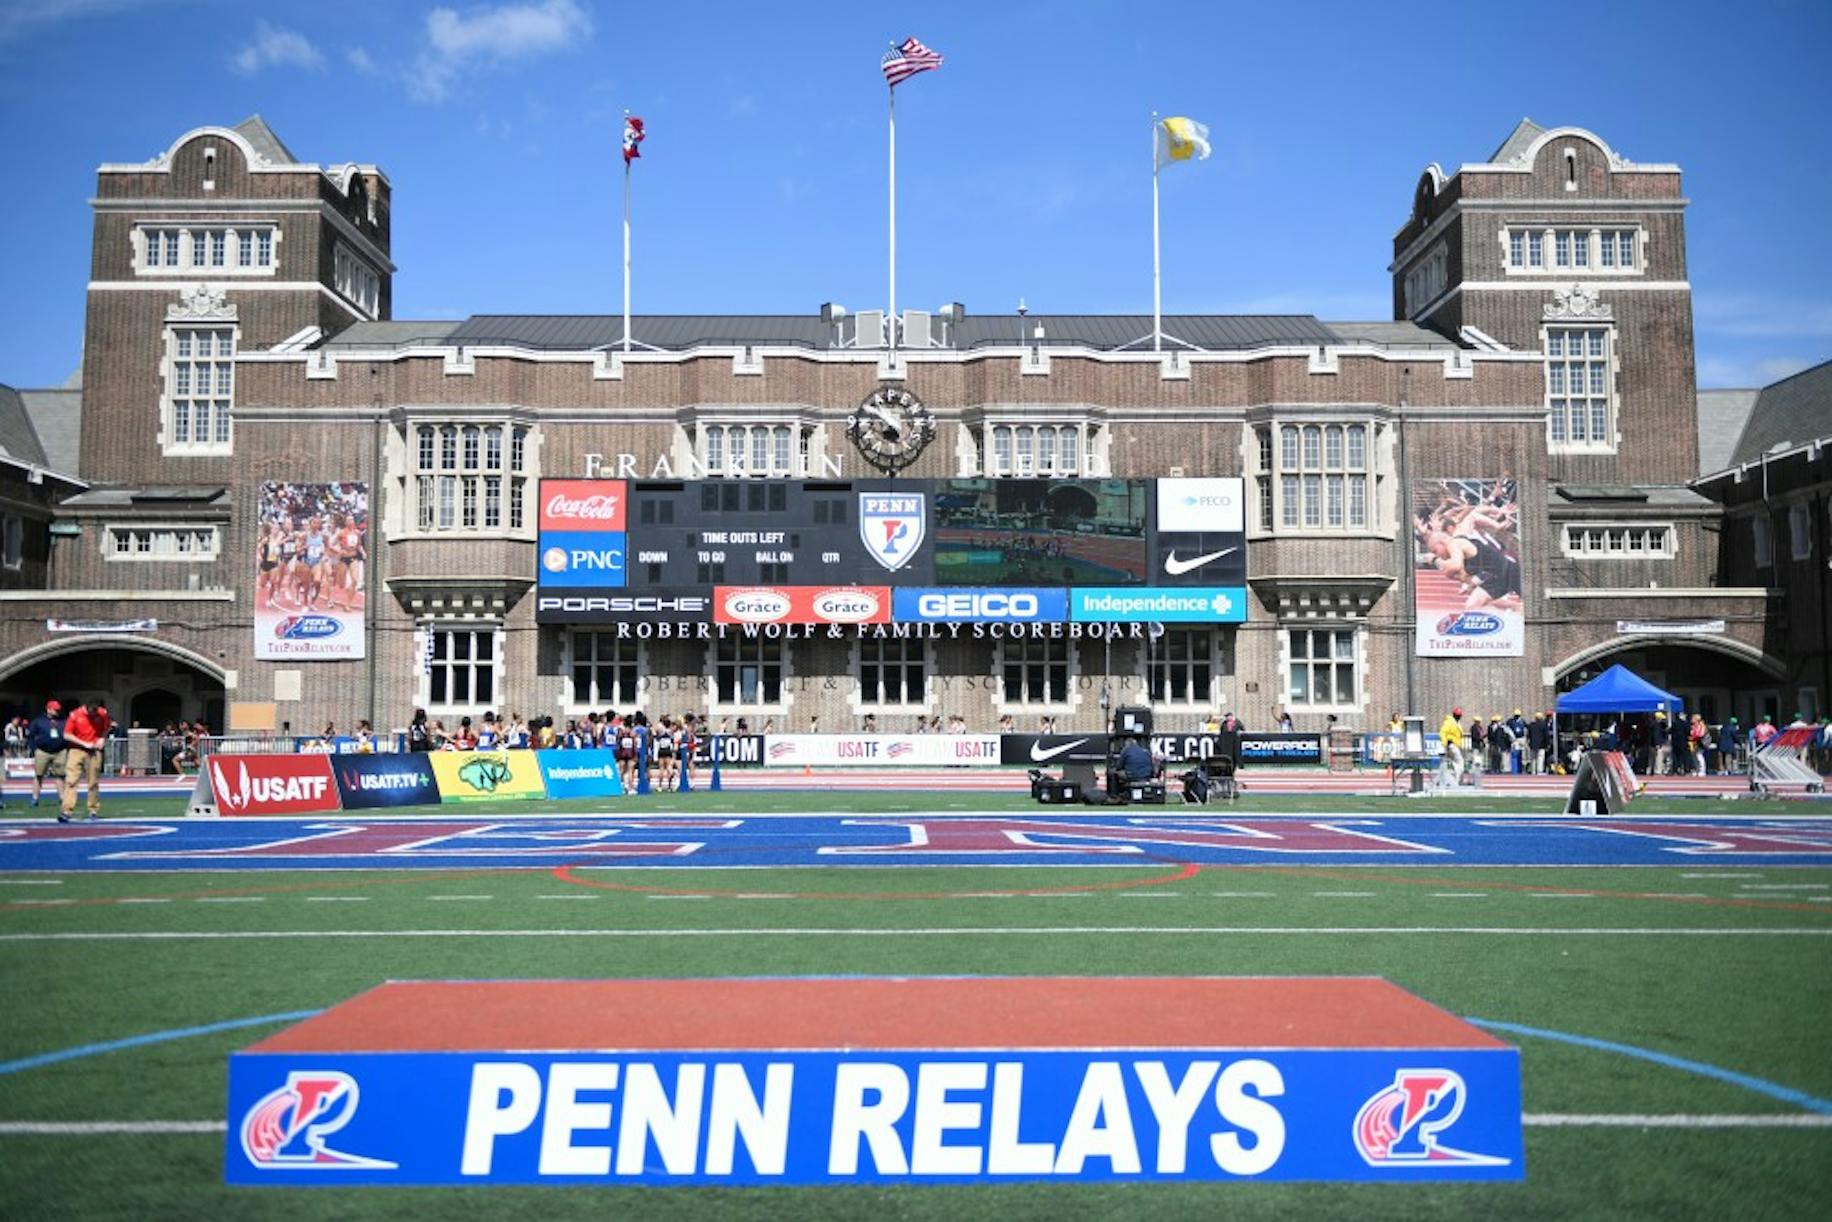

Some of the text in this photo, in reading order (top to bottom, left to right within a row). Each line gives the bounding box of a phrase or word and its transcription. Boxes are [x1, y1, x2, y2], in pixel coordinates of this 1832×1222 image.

[584, 454, 1106, 479] FRANKLIN FIELD
[865, 498, 918, 513] PENN
[1199, 496, 1232, 507] PECO
[702, 532, 785, 543] TIME OUTS LEFT
[570, 550, 622, 570] PNC
[638, 551, 668, 563] DOWN
[697, 551, 726, 563] TO GO
[755, 551, 794, 563] BALL ON
[821, 552, 841, 563] QTR
[539, 598, 704, 613] PORSCHE
[734, 600, 782, 613] Grace
[822, 600, 870, 613] Grace
[919, 595, 1038, 617] GEICO
[1084, 595, 1208, 613] Independence
[617, 623, 730, 639] ROBERT
[742, 623, 817, 639] WOLF
[827, 623, 844, 639] &
[857, 623, 962, 639] FAMILY
[838, 742, 879, 758] USATF
[955, 742, 997, 758] USATF
[1241, 741, 1319, 751] POWERADE
[548, 767, 603, 780] Independence
[252, 776, 329, 801] USATF
[461, 1059, 1286, 1175] PENN RELAYS
